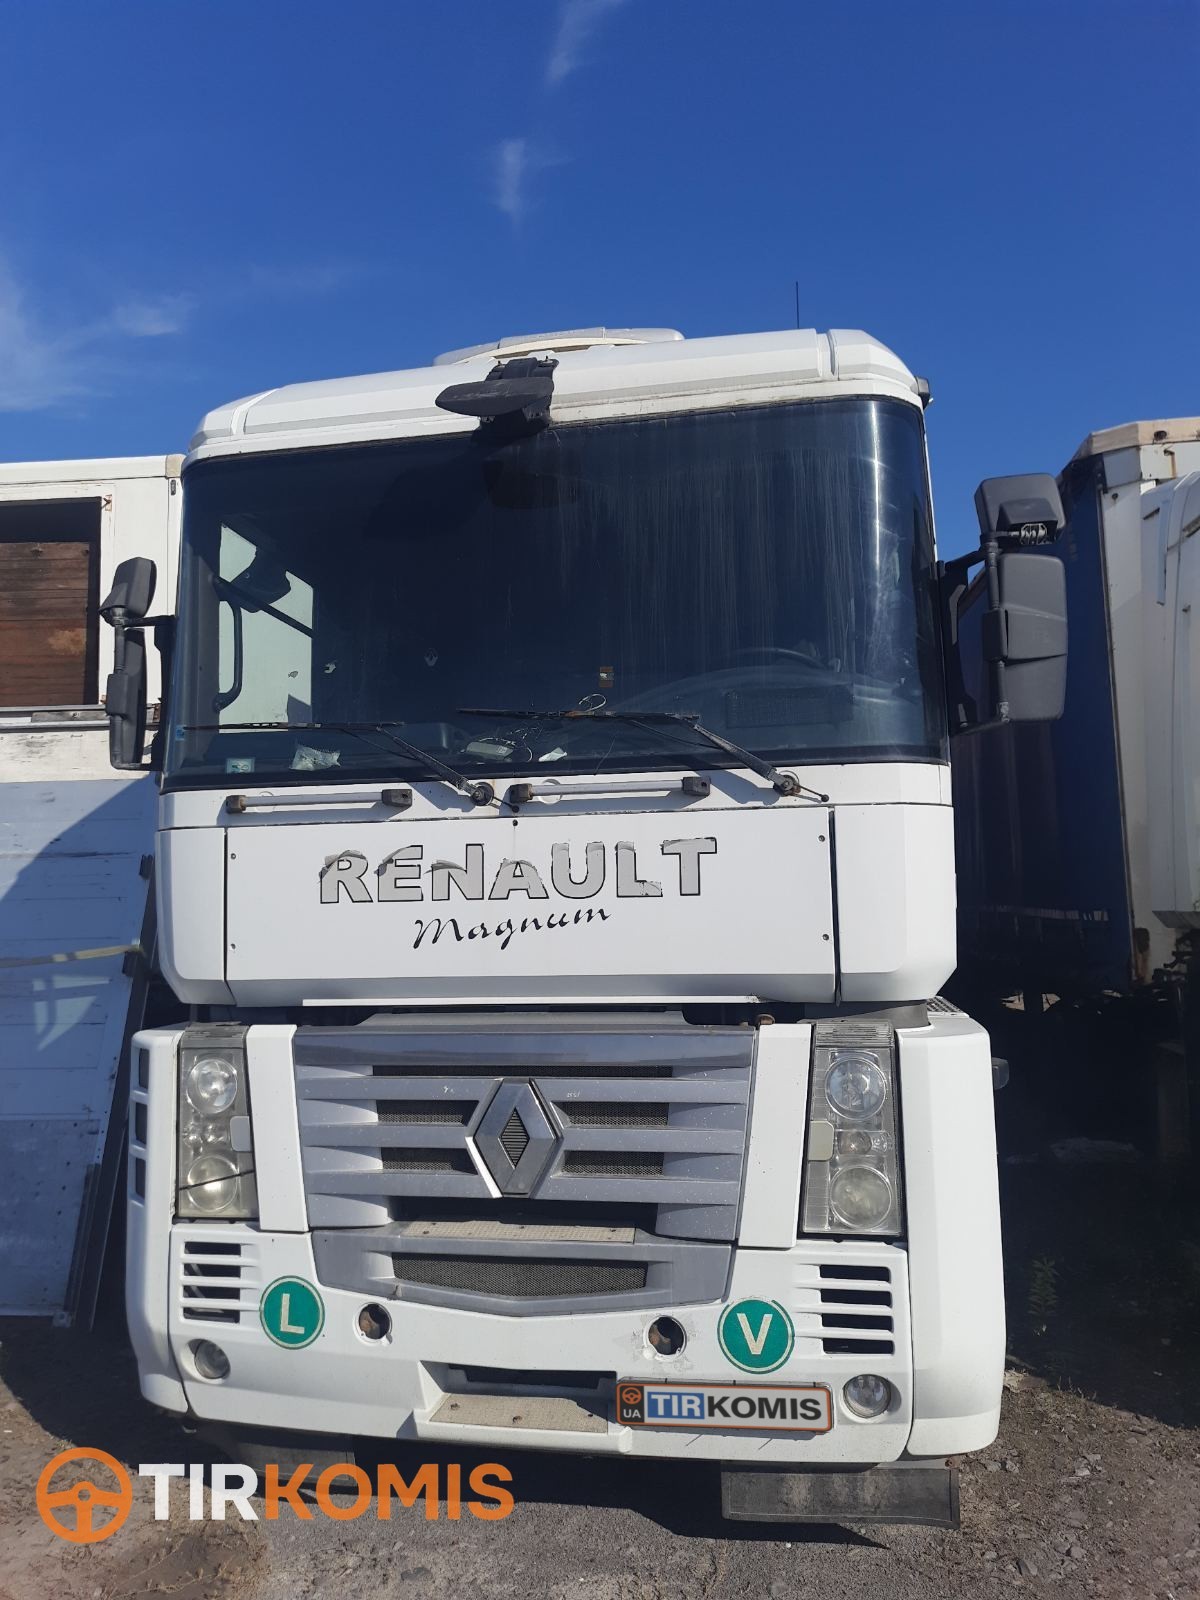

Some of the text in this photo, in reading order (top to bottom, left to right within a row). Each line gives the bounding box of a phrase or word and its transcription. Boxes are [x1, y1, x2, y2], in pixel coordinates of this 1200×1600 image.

[318, 836, 717, 904] RENAULT
[413, 907, 611, 950] Magnum
[280, 1293, 305, 1335] L
[736, 1312, 773, 1355] V
[623, 1408, 641, 1418] UA
